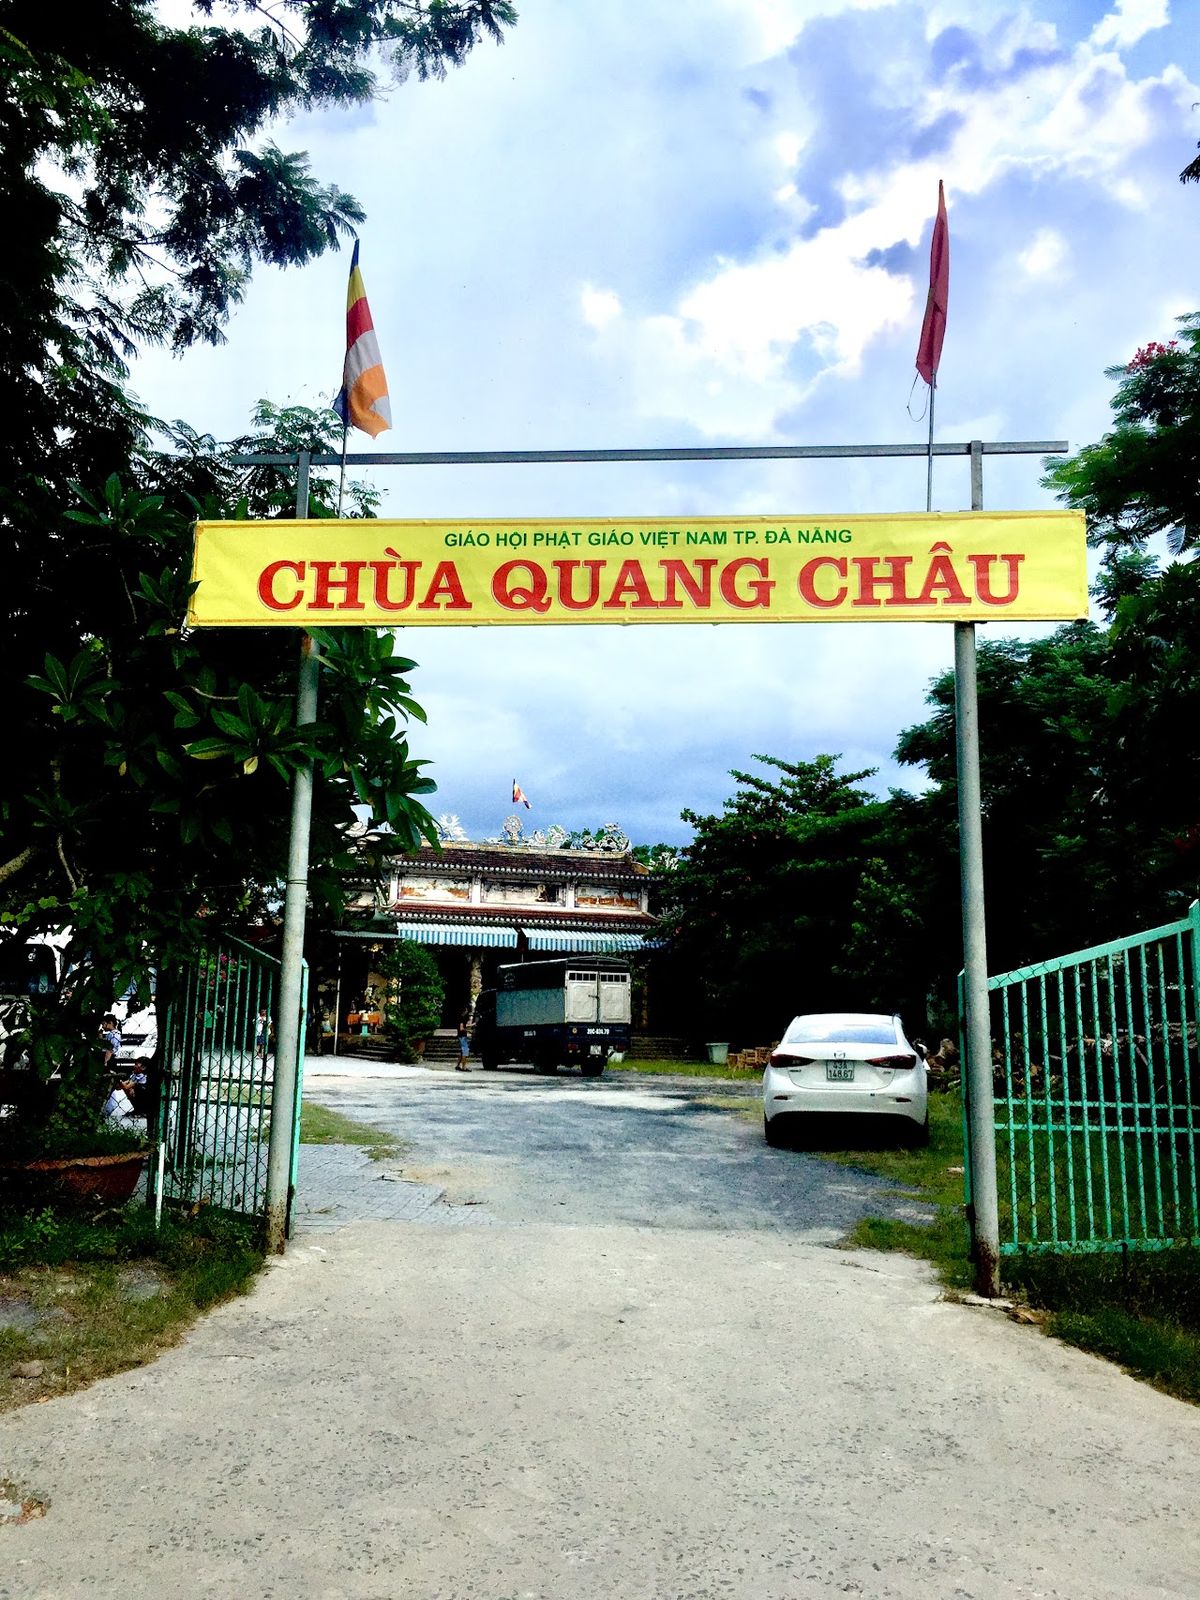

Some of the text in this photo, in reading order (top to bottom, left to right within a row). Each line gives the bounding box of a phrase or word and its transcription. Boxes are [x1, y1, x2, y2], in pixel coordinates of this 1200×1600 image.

[444, 530, 491, 547] GIÁO
[495, 531, 528, 550] HỘI
[533, 530, 583, 549] PHẬT
[588, 529, 635, 547] GIÁO
[639, 530, 681, 549] VIỆT
[686, 531, 728, 546] NAM
[732, 530, 760, 545] TP.
[764, 527, 792, 545] ĐÀ
[256, 541, 1026, 615] CHÙA QUANG CHÂU
